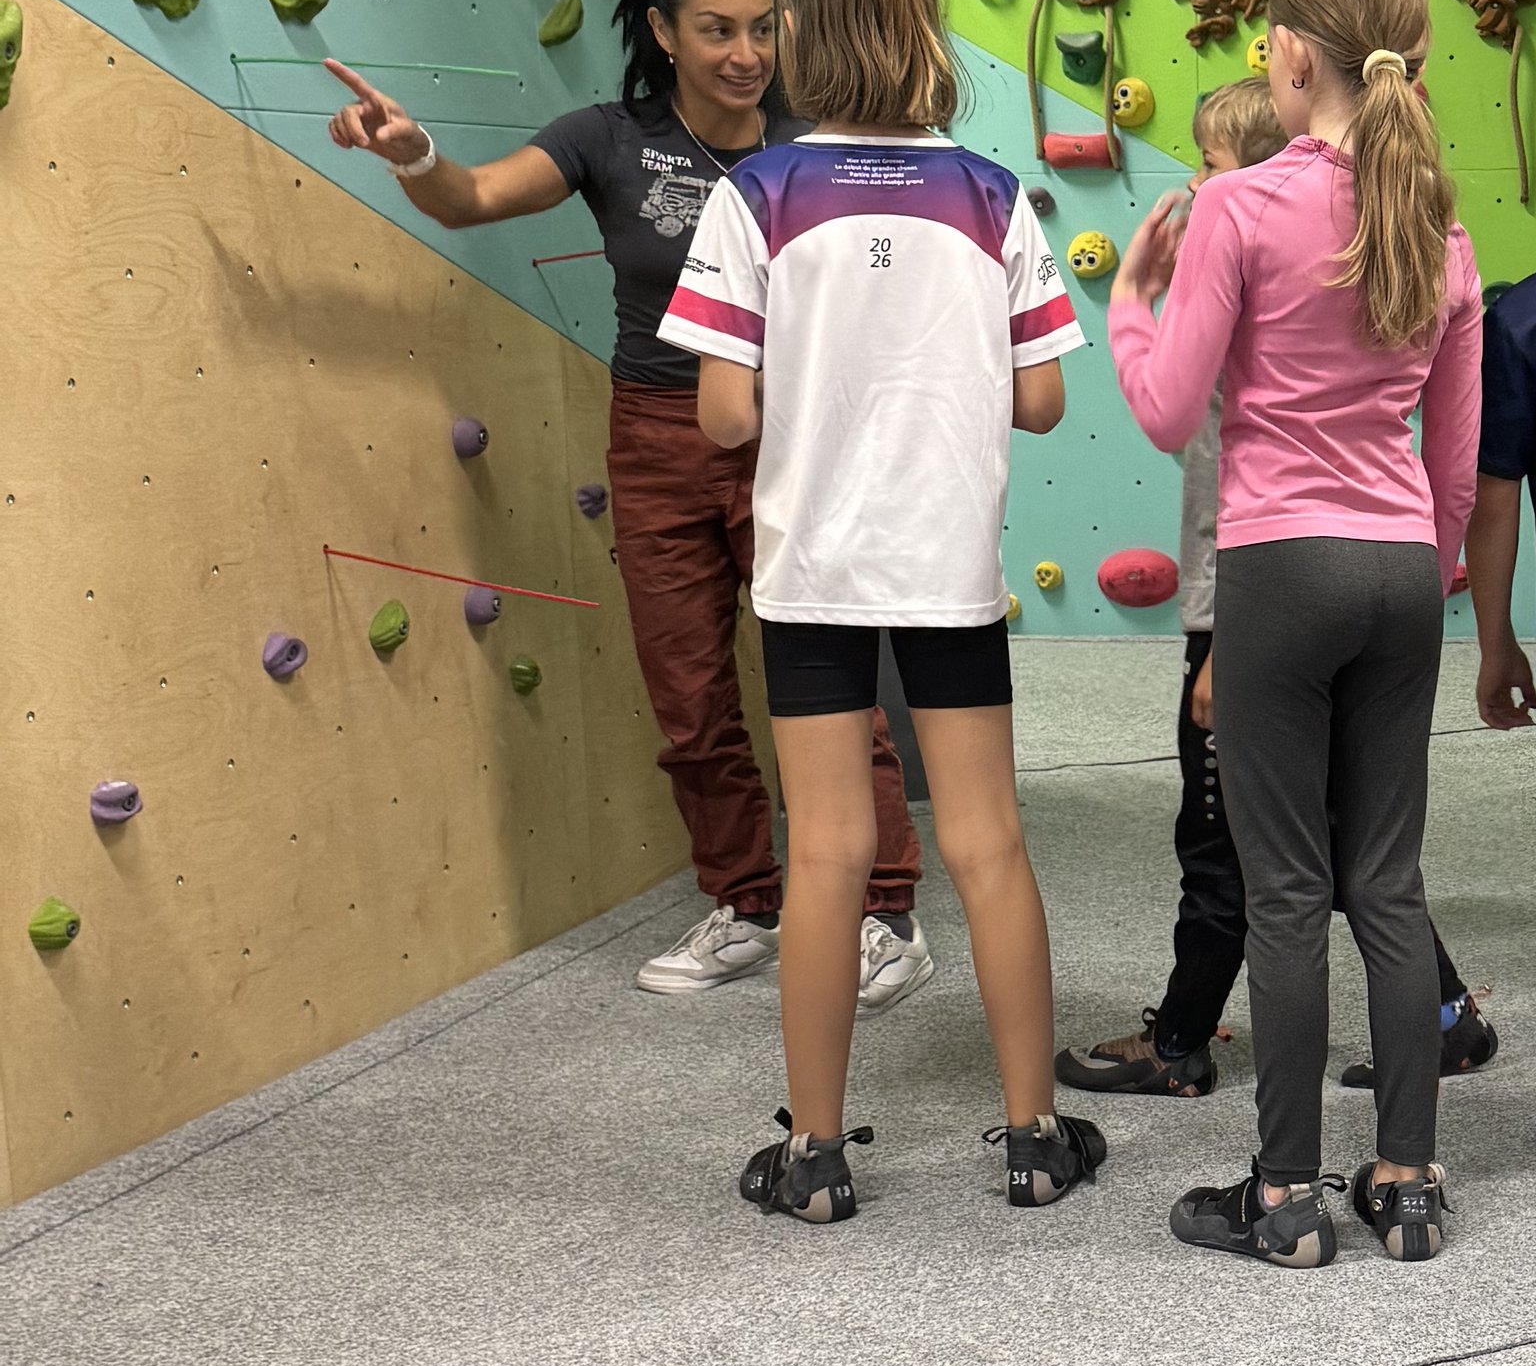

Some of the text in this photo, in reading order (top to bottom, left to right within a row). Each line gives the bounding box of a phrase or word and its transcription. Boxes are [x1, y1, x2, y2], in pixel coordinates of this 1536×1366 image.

[642, 147, 693, 168] SPARTA
[640, 158, 673, 173] TEAM
[869, 238, 892, 252] 20
[870, 253, 892, 268] 26
